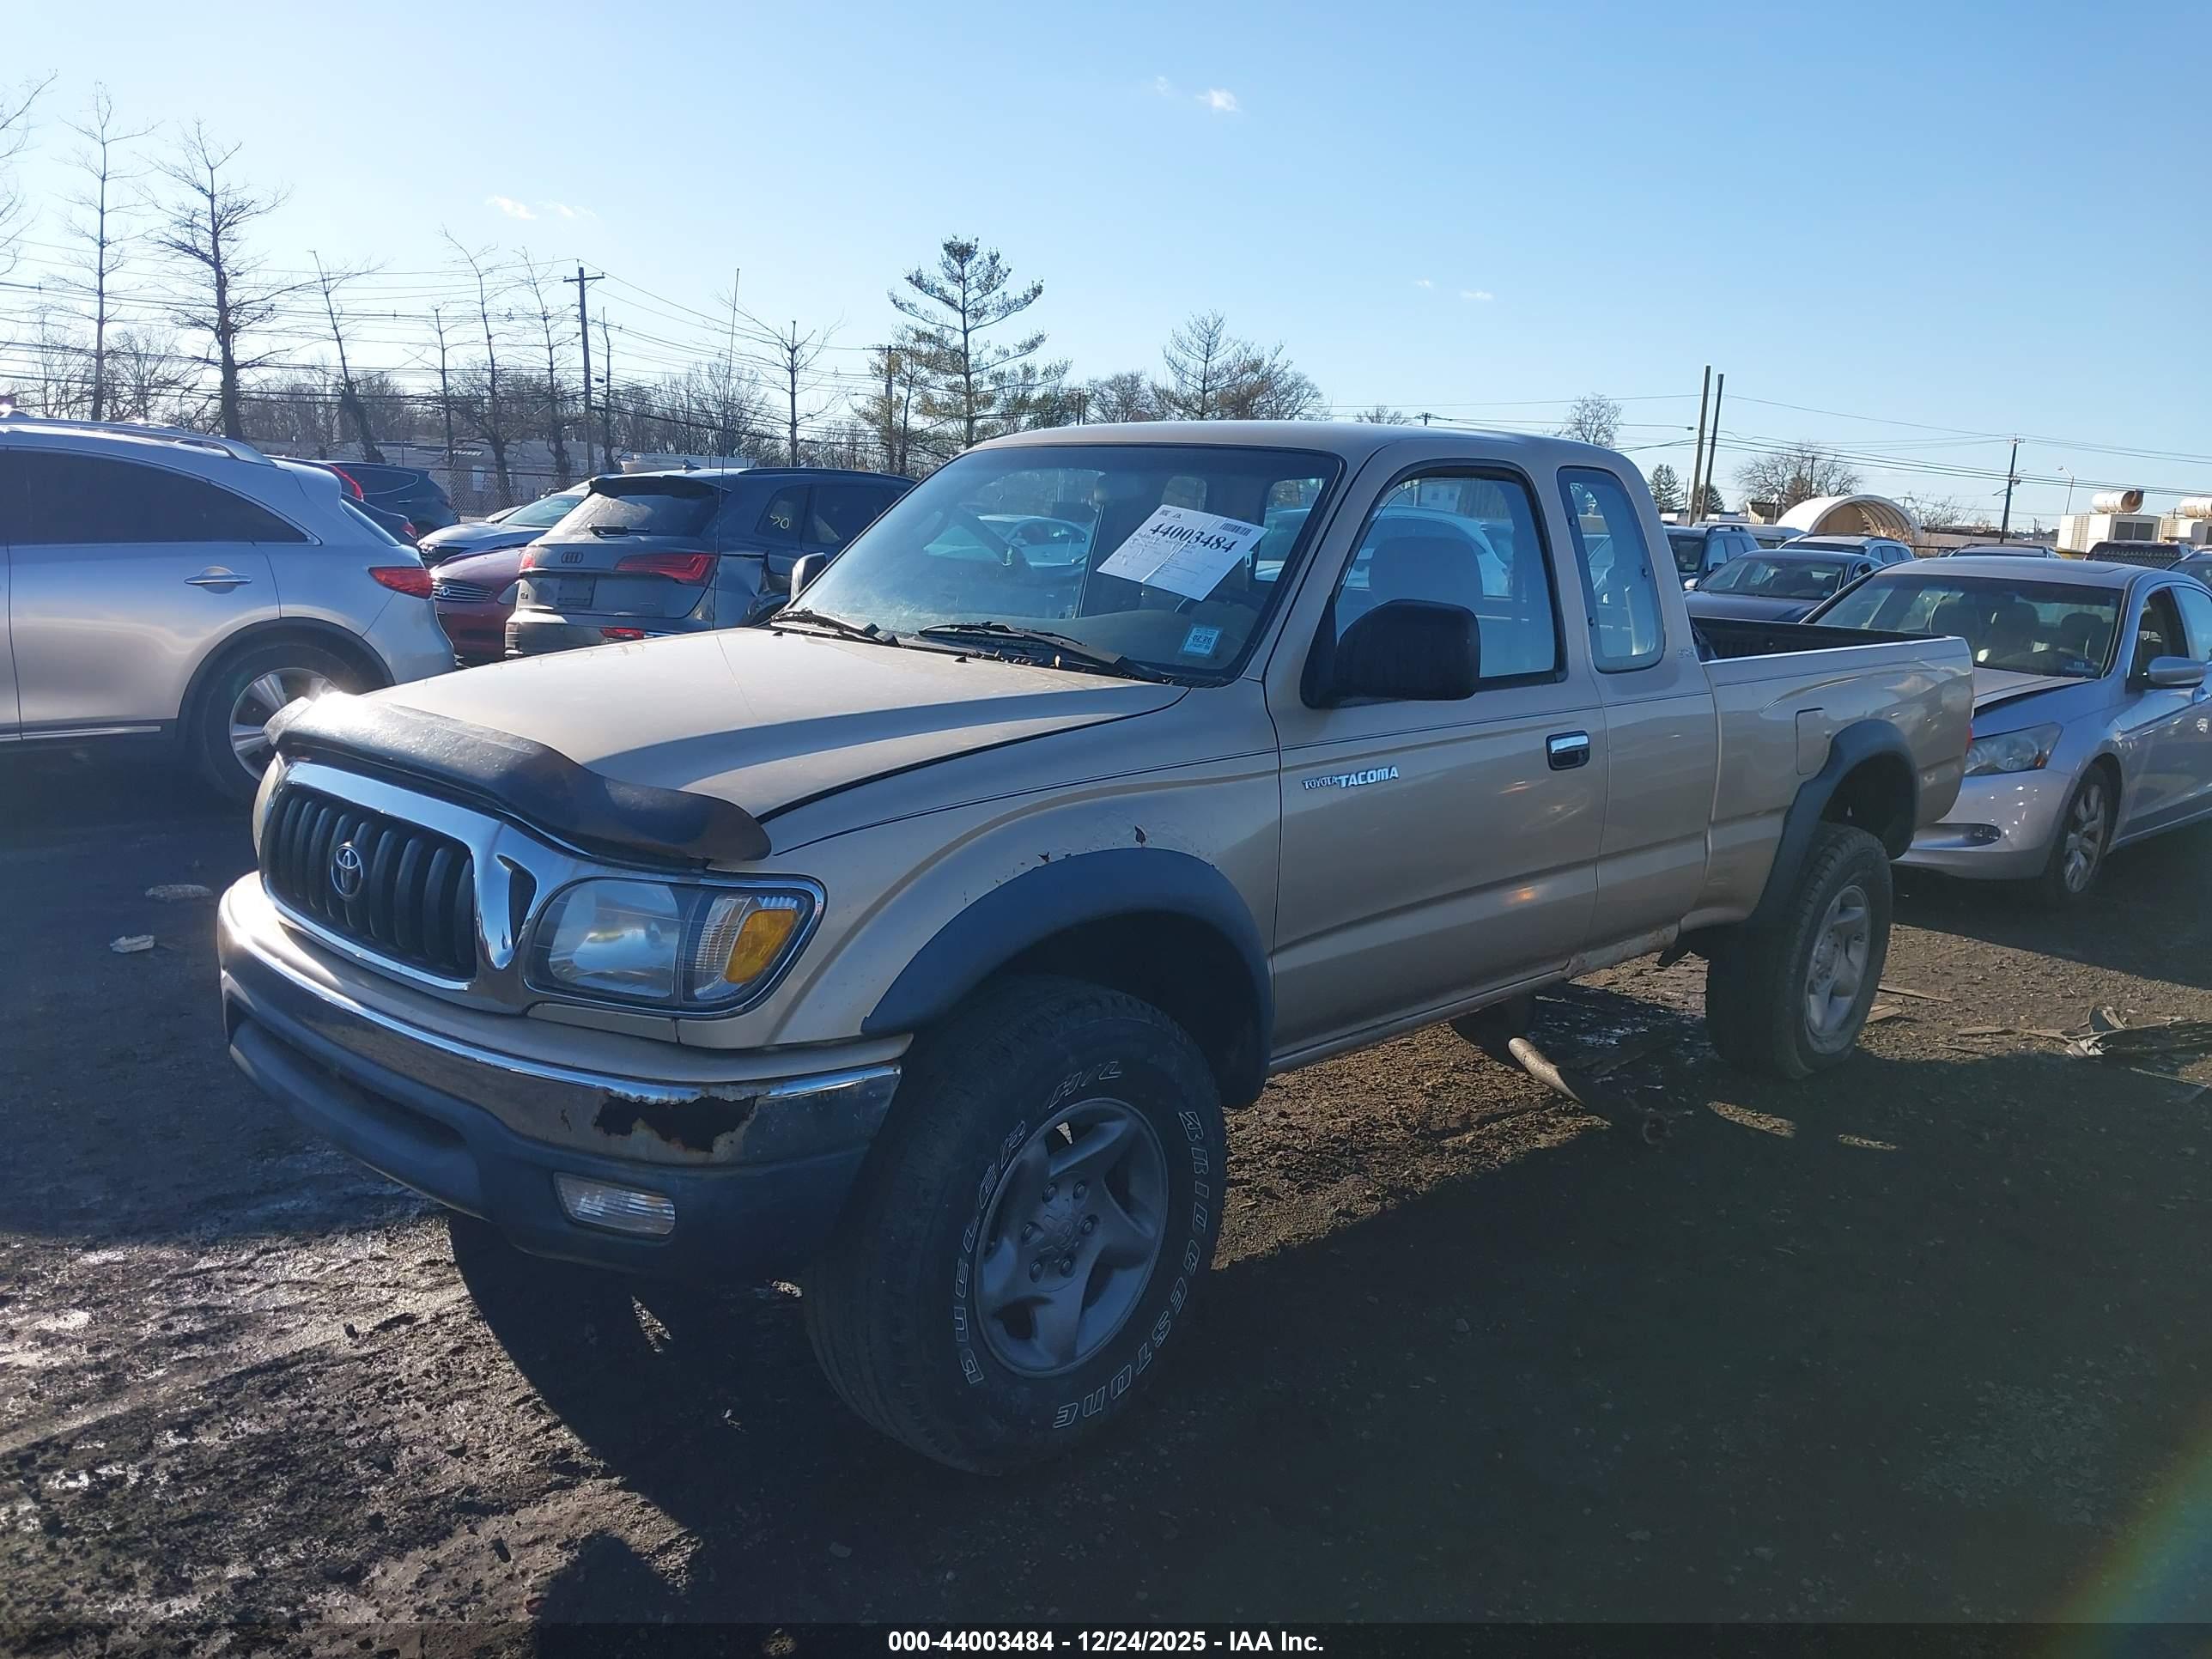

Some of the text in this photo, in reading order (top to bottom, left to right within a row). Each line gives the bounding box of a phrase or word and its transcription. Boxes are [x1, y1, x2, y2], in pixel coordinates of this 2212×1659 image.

[1149, 522, 1238, 553] 44003484
[1303, 766, 1400, 790] TOYOTA TACOMA
[1053, 1111, 1210, 1429] BRIDGESTONE
